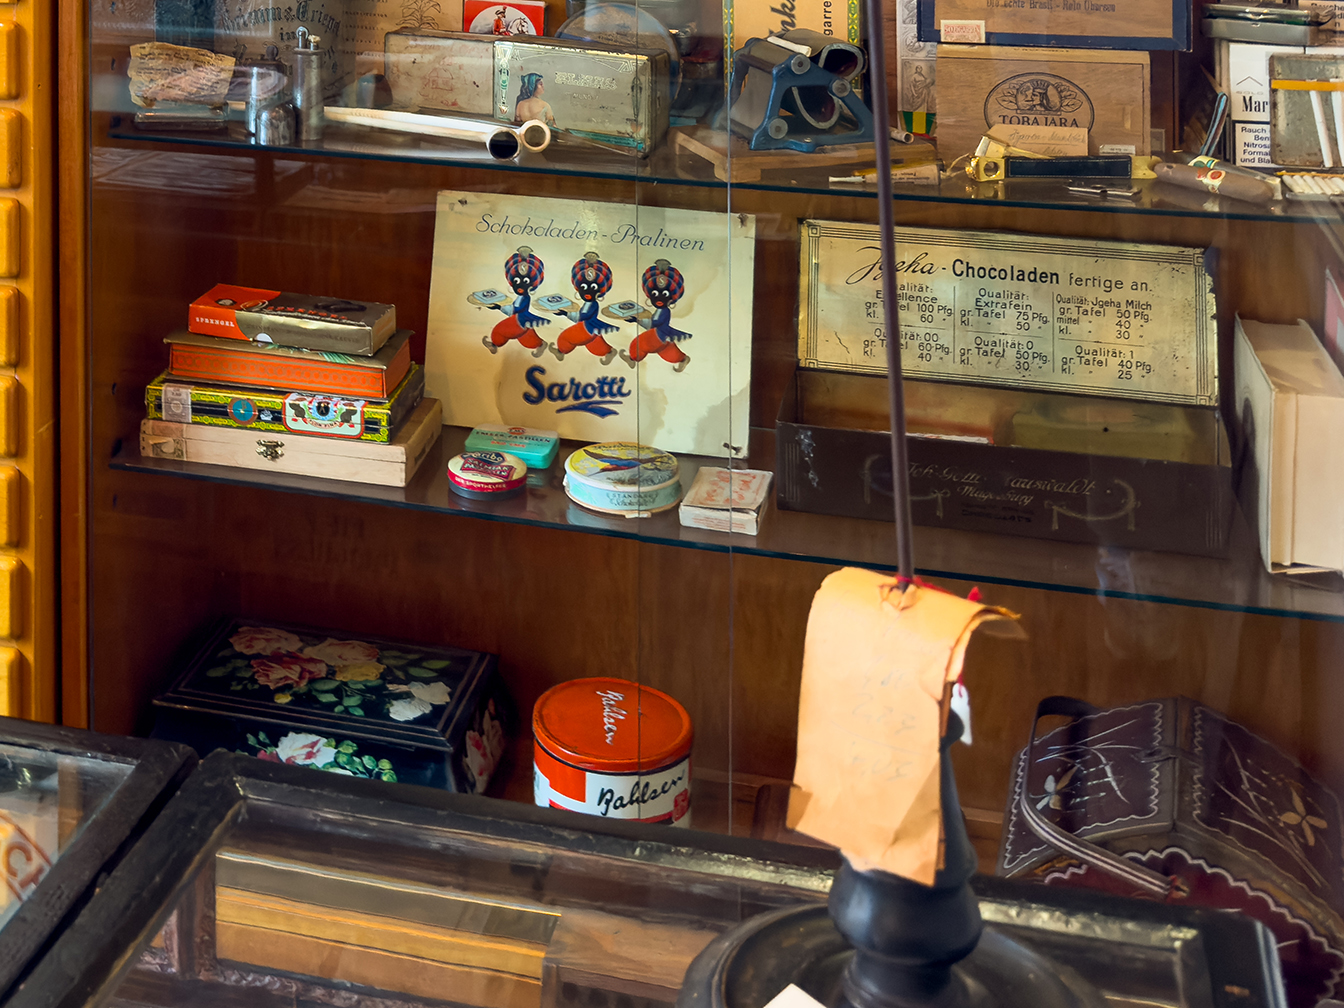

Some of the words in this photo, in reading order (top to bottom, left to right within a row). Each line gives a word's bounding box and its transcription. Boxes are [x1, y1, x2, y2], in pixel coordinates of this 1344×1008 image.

[1242, 95, 1269, 113] Mar
[475, 212, 598, 242] Schokoladen
[611, 223, 705, 252] Pralinen
[952, 258, 1059, 285] Chocoladen
[1069, 272, 1124, 293] fertige
[1130, 280, 1153, 292] an.
[899, 282, 933, 293] alität:
[978, 287, 1029, 301] Qualität:
[865, 301, 878, 309] gr.
[917, 303, 934, 313] 100
[975, 297, 1033, 311] Extrafein
[1056, 293, 1089, 306] Qualität:
[1091, 297, 1121, 309] Jgeha
[1126, 299, 1152, 311] Milch
[866, 309, 878, 318] kl.
[920, 314, 933, 323] 60
[960, 308, 973, 317] gr.
[975, 307, 1005, 319] Tafel
[1016, 311, 1029, 320] 75
[1032, 312, 1050, 324] Pfg.
[1059, 306, 1072, 315] gr.
[1074, 305, 1106, 317] Tafel
[1116, 309, 1131, 319] 50
[1134, 310, 1152, 323] Pfg.
[195, 316, 235, 328] SPRENGEL
[960, 317, 973, 326] kl.
[1016, 322, 1030, 331] 50
[1056, 315, 1080, 325] mittel
[1116, 320, 1131, 329] 40
[1059, 325, 1072, 334] kl.
[1116, 330, 1130, 339] 30
[863, 338, 876, 347] gr.
[918, 342, 932, 351] 60
[935, 343, 952, 355] Pfg.
[974, 336, 1024, 349] Qualität:
[863, 348, 875, 357] kl.
[918, 353, 932, 362] 40
[959, 347, 973, 356] gr.
[975, 346, 1005, 358] Tafel
[1016, 350, 1029, 360] 50
[1032, 352, 1050, 364] Pfg.
[1075, 345, 1125, 358] Qualität:
[960, 357, 973, 366] kl.
[1015, 361, 1029, 371] 30
[1061, 356, 1075, 365] gr.
[1076, 355, 1108, 367] Tafel
[1118, 360, 1132, 369] 40
[1136, 360, 1155, 373] Pfg.
[1061, 365, 1074, 375] kl.
[1118, 369, 1132, 380] 25
[522, 365, 631, 406] Sarotti
[506, 433, 551, 443] PASTILLEN
[1006, 476, 1096, 495] auswaldt
[596, 690, 627, 745] Bahlsen
[598, 769, 685, 816] Bahlsen
